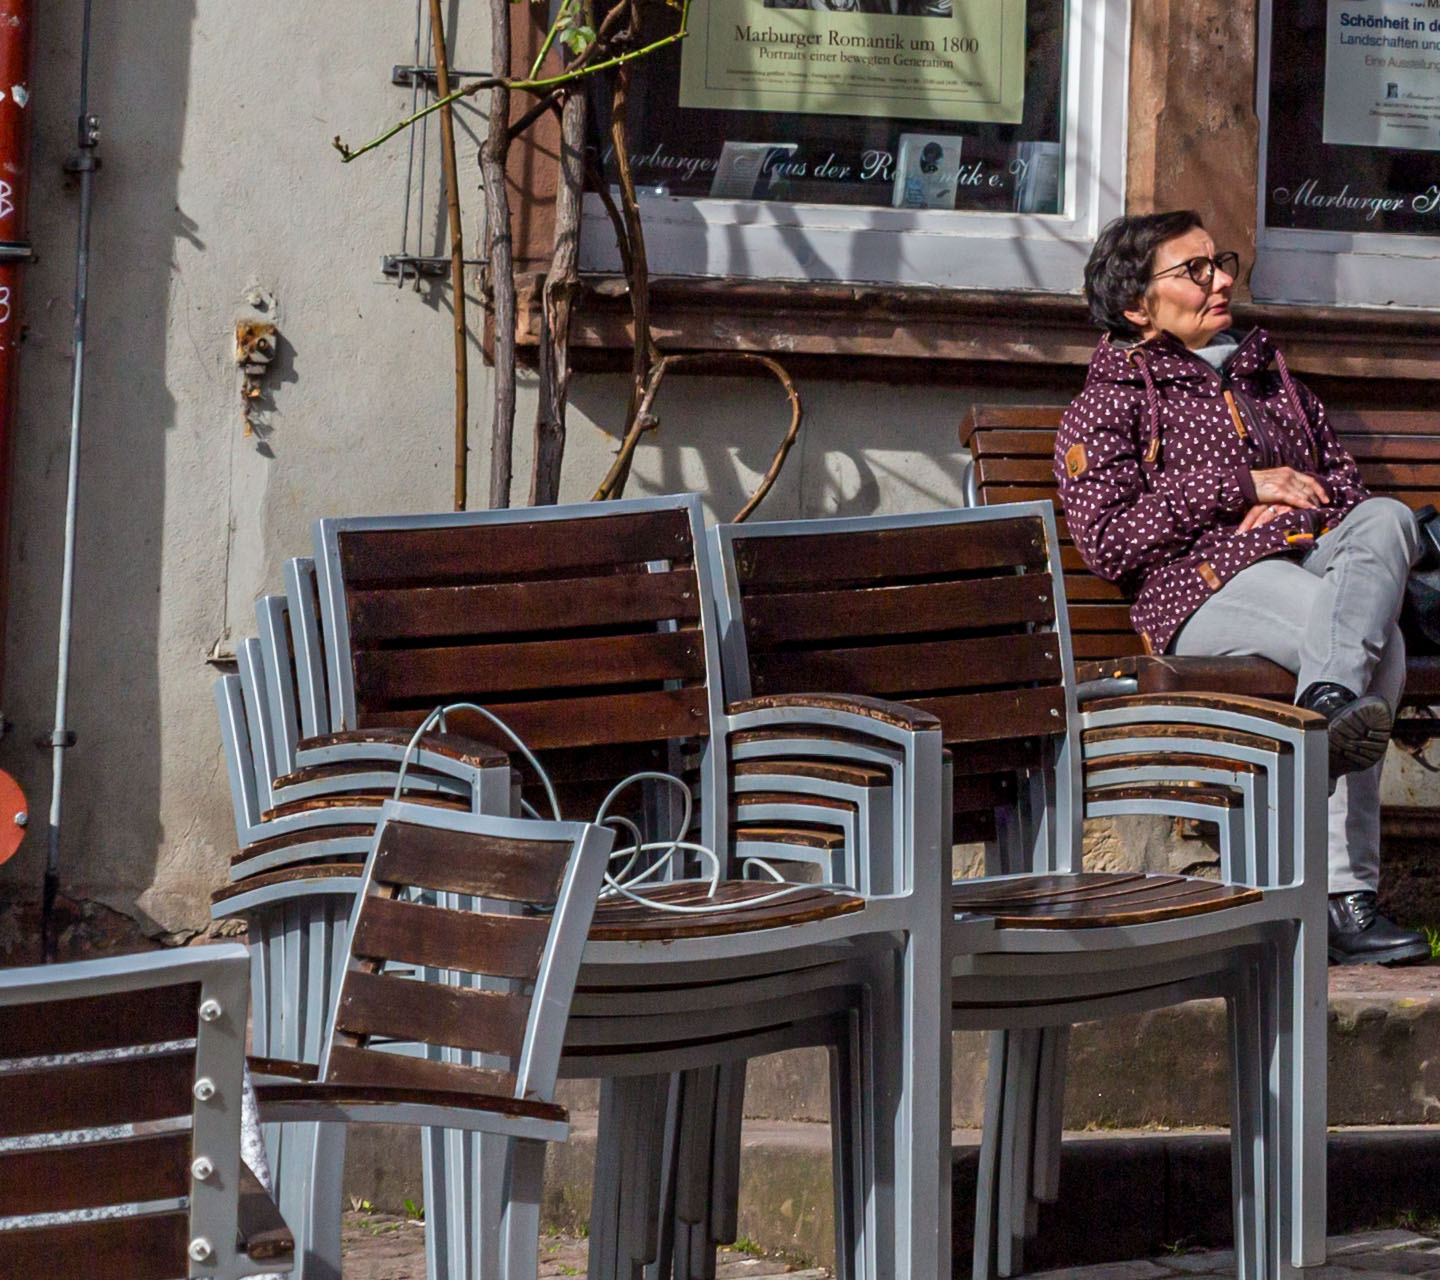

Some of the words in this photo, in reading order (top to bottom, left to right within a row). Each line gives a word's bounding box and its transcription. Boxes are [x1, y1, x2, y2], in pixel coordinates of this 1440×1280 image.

[1340, 13, 1409, 31] Schönheit
[1413, 15, 1425, 31] in
[734, 25, 823, 48] Marburger
[828, 29, 904, 50] Romantik
[910, 39, 935, 51] um
[942, 37, 979, 54] 1800
[1340, 32, 1418, 49] Landschaften
[759, 47, 806, 61] Portraits
[809, 51, 836, 63] einer
[840, 51, 891, 67] bewegten
[893, 54, 954, 69] Generation
[813, 153, 851, 179] der
[1272, 179, 1405, 220] Marburger
